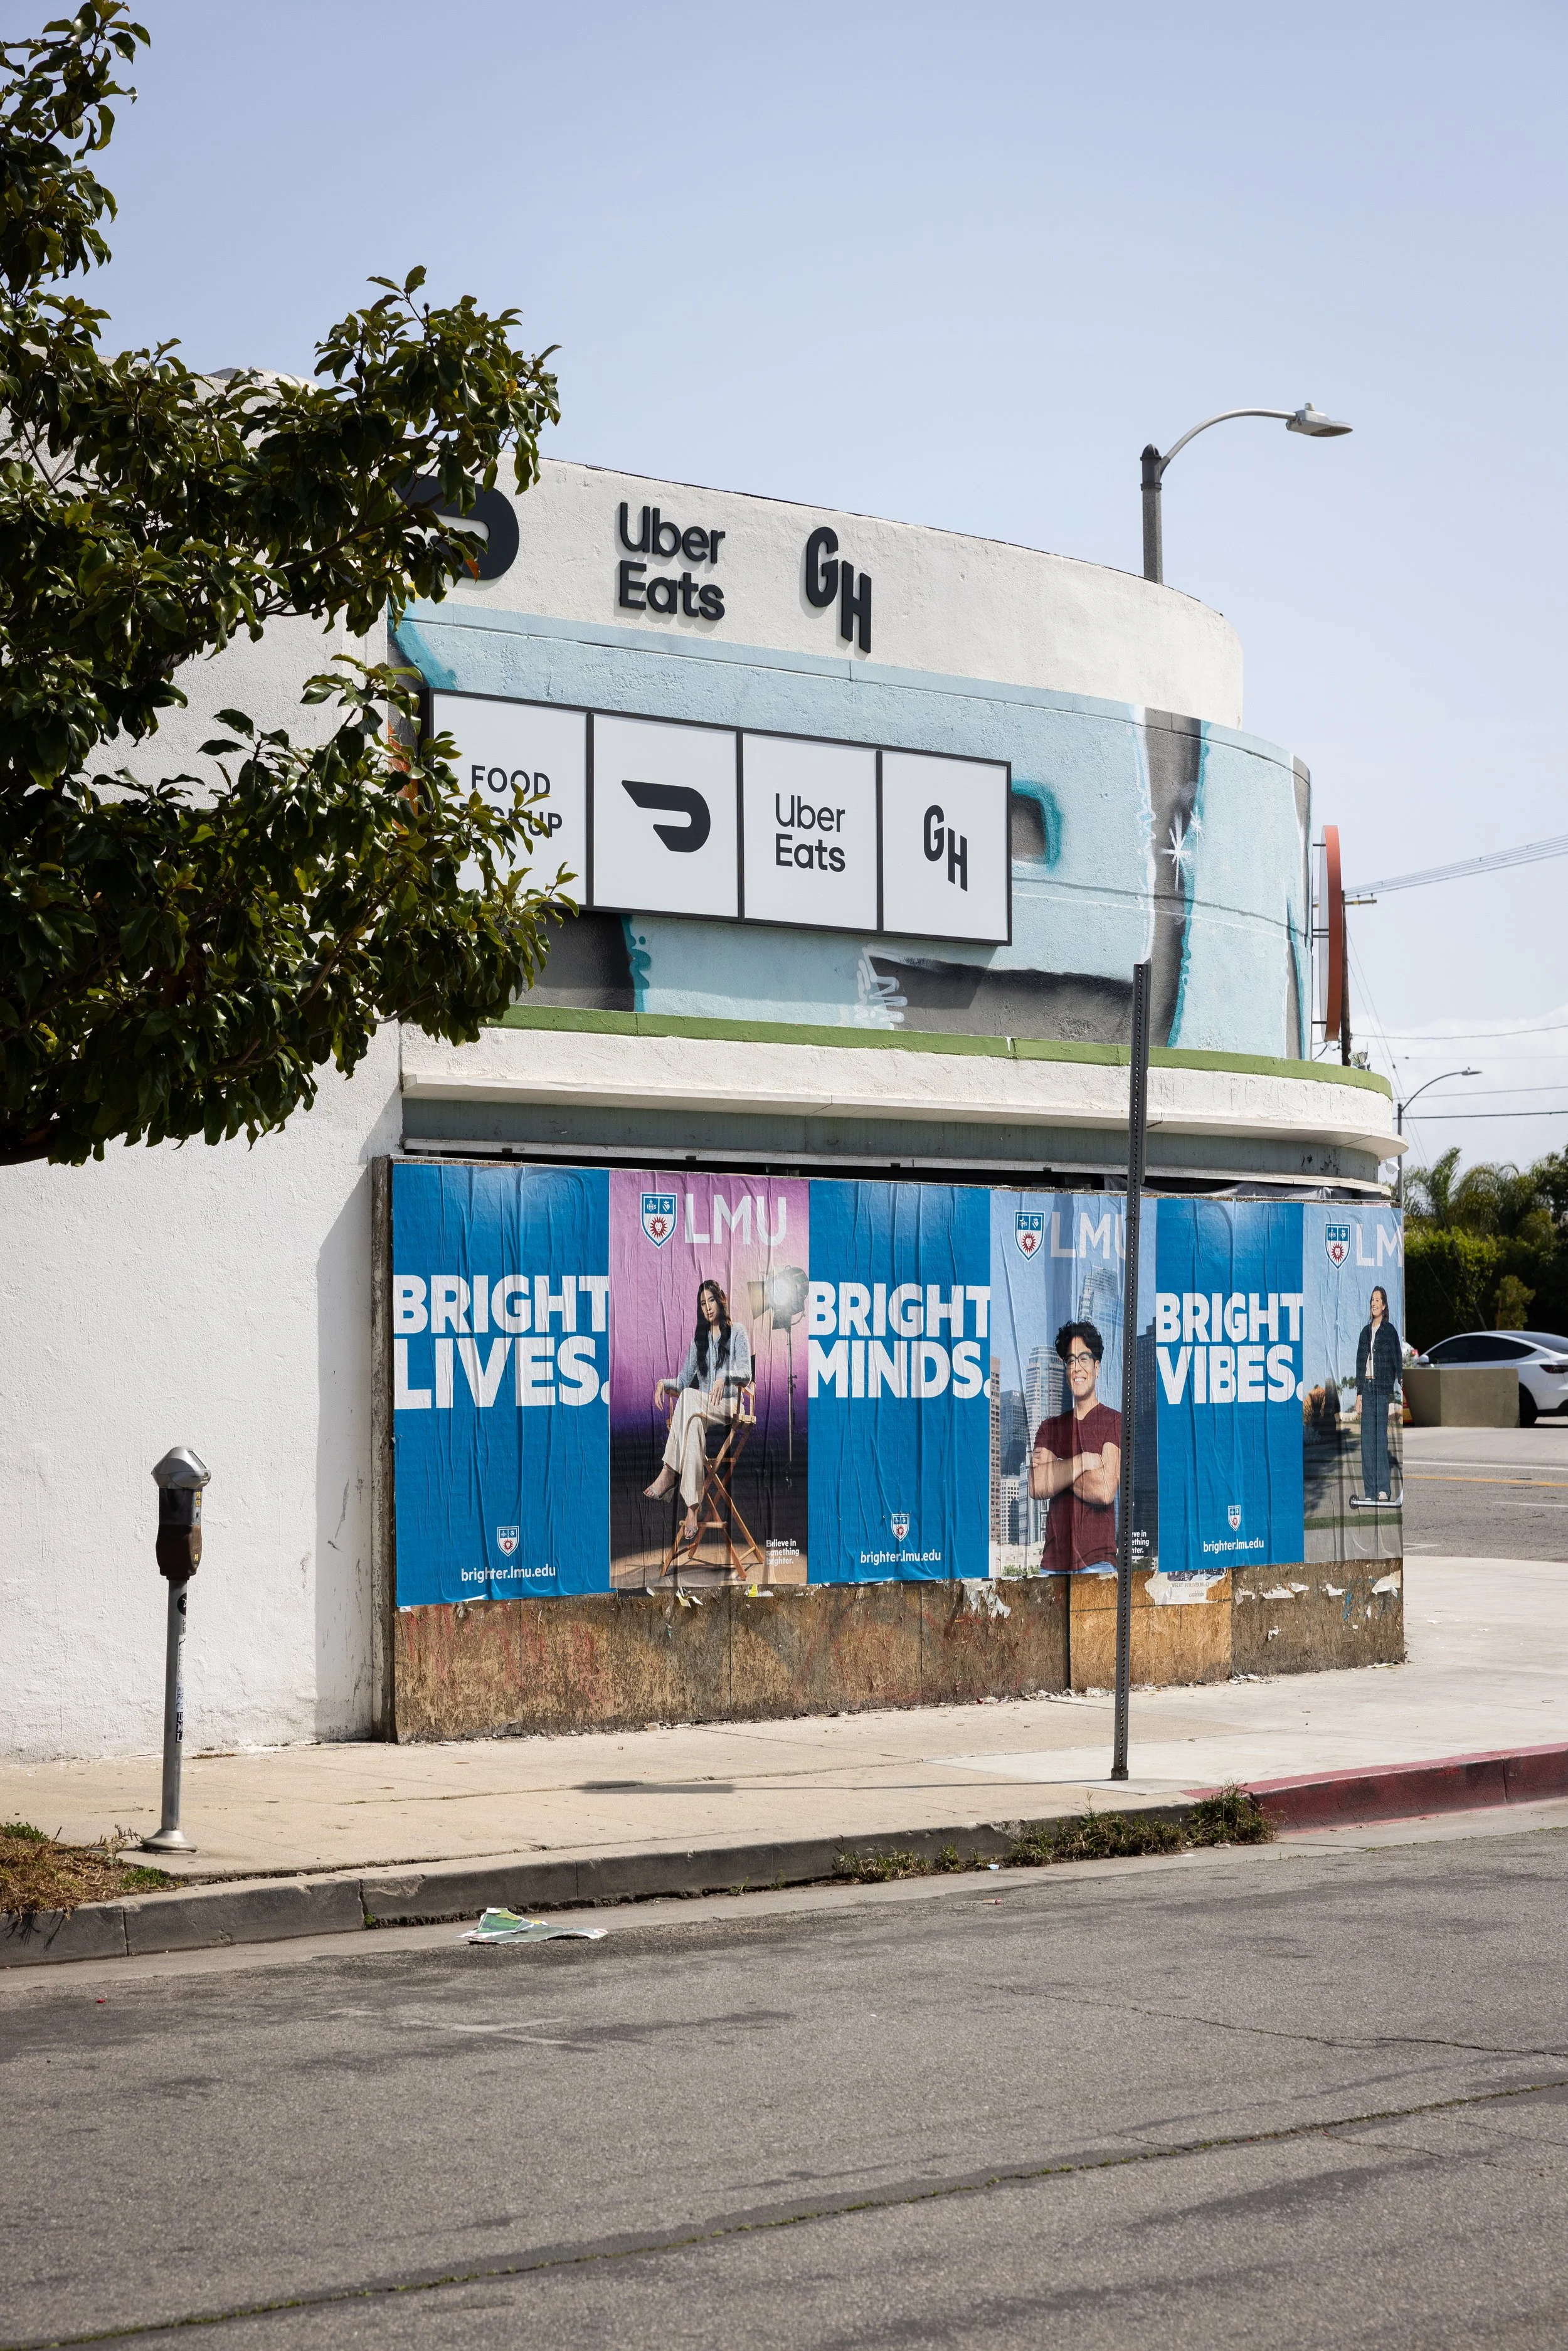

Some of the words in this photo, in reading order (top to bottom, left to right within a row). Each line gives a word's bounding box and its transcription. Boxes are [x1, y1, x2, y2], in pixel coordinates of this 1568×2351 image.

[620, 502, 725, 564] Uber
[619, 560, 724, 620] Eats
[806, 527, 871, 653] GH
[471, 765, 550, 795] FOOD
[776, 793, 845, 832] Uber
[776, 834, 845, 872] Eats
[924, 805, 967, 891] GH
[685, 1193, 786, 1246] LMU
[394, 1275, 609, 1334] BRIGHT
[808, 1282, 990, 1337] BRIGHT
[1156, 1293, 1302, 1342] BRIGHT
[394, 1336, 609, 1409] LIVES.
[808, 1340, 990, 1399] MINDS.
[1156, 1344, 1303, 1404] VIBES.
[860, 1549, 941, 1565] brighter.lmu.edu
[1132, 1538, 1150, 1546] ething
[1203, 1537, 1264, 1554] brighter.lmu.edu
[461, 1564, 555, 1583] brighter.lmu.edu
